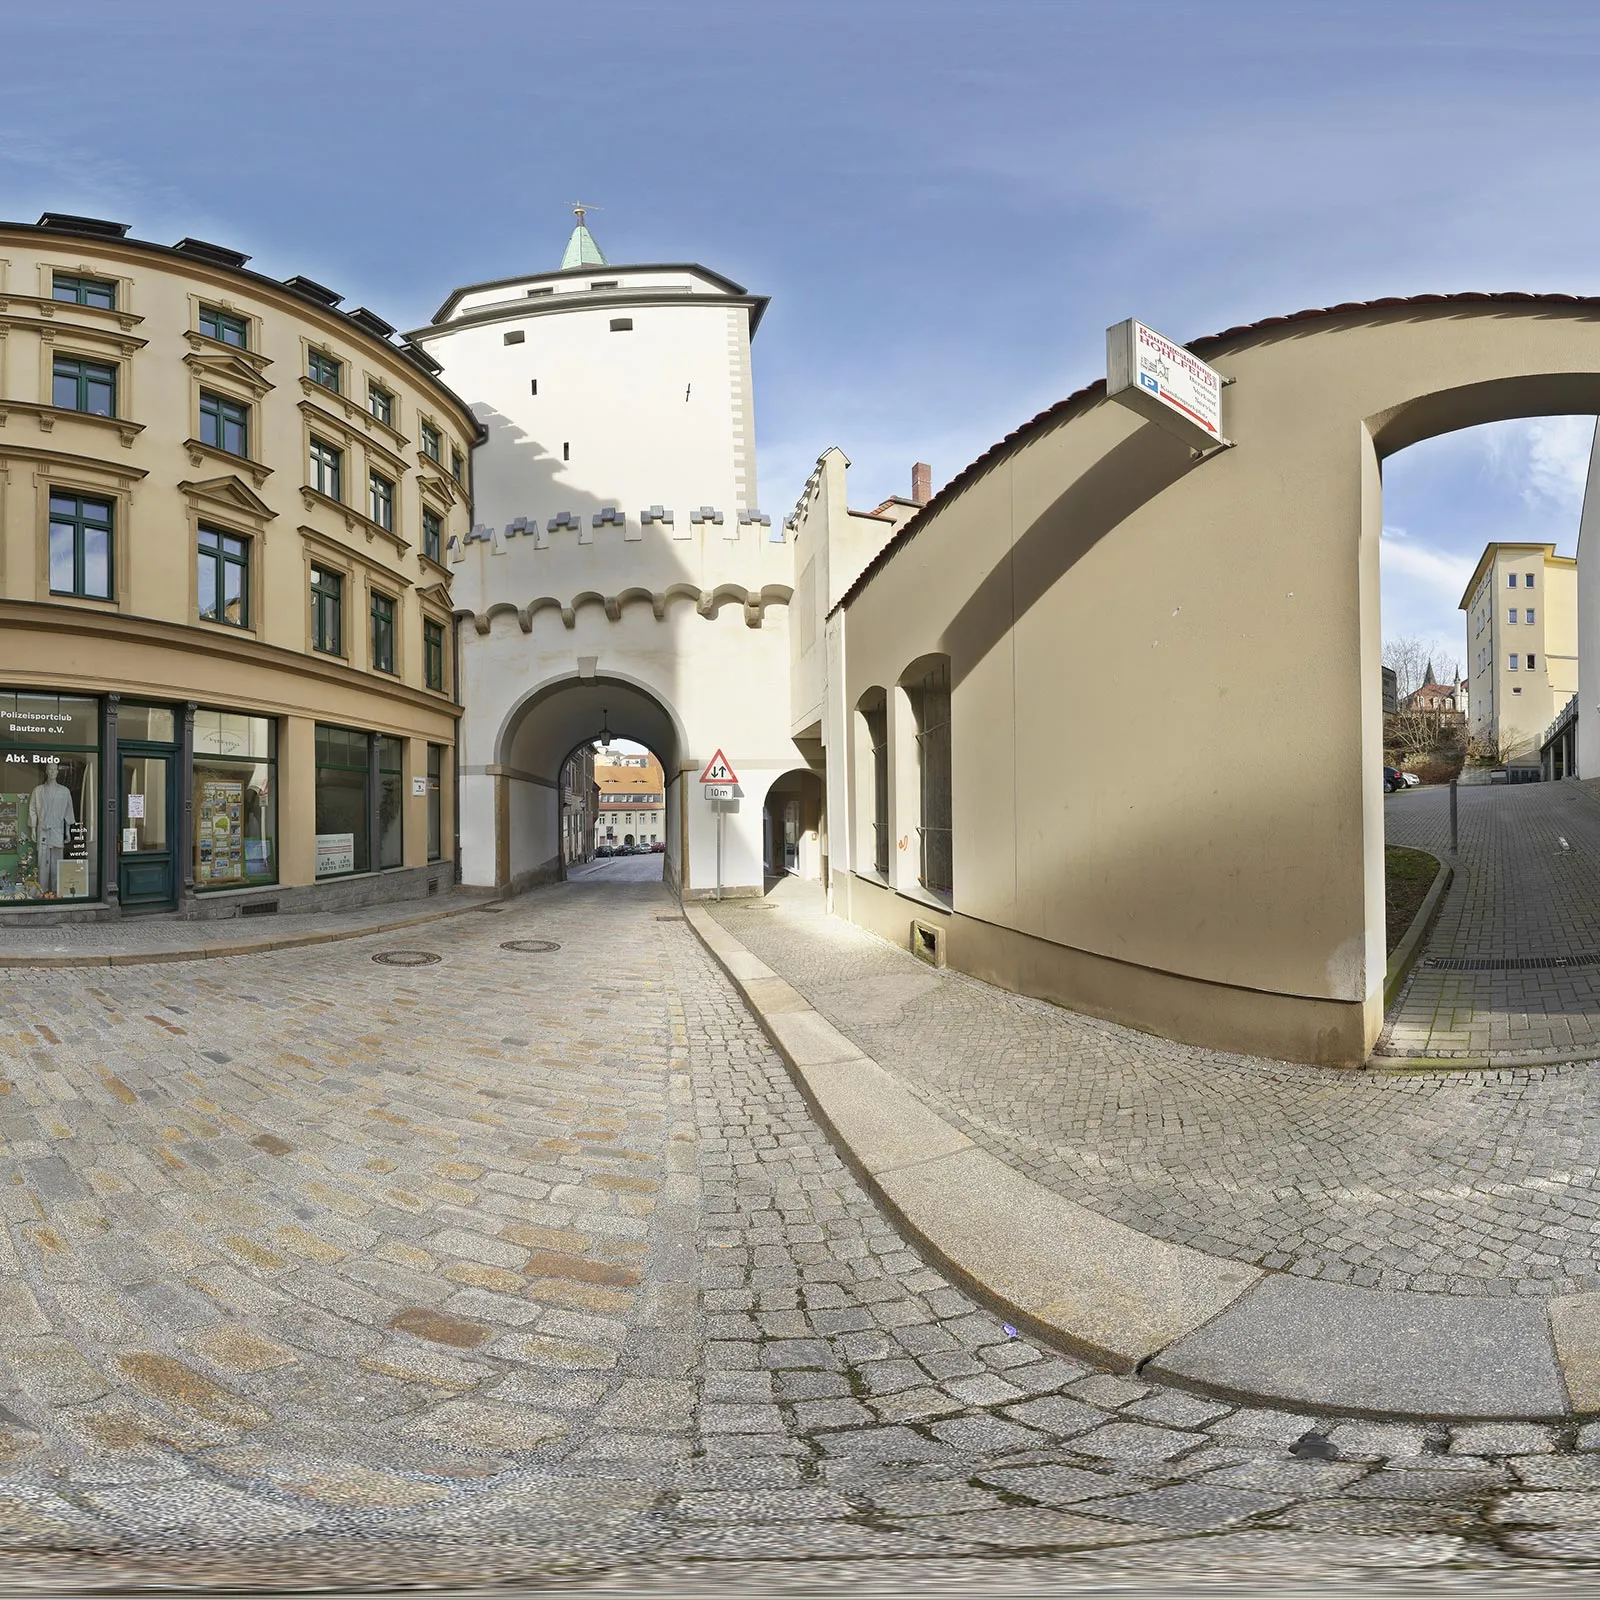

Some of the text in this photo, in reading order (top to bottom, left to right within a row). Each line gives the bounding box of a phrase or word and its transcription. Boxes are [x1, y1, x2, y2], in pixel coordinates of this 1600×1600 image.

[1140, 327, 1212, 380] Raumgestaltung
[1140, 335, 1212, 386] HOHLFELD
[0, 710, 72, 721] Polizeisportclub
[9, 724, 65, 734] Bautzen e.V.
[5, 753, 60, 764] Abt. Budo
[711, 788, 719, 797] 10
